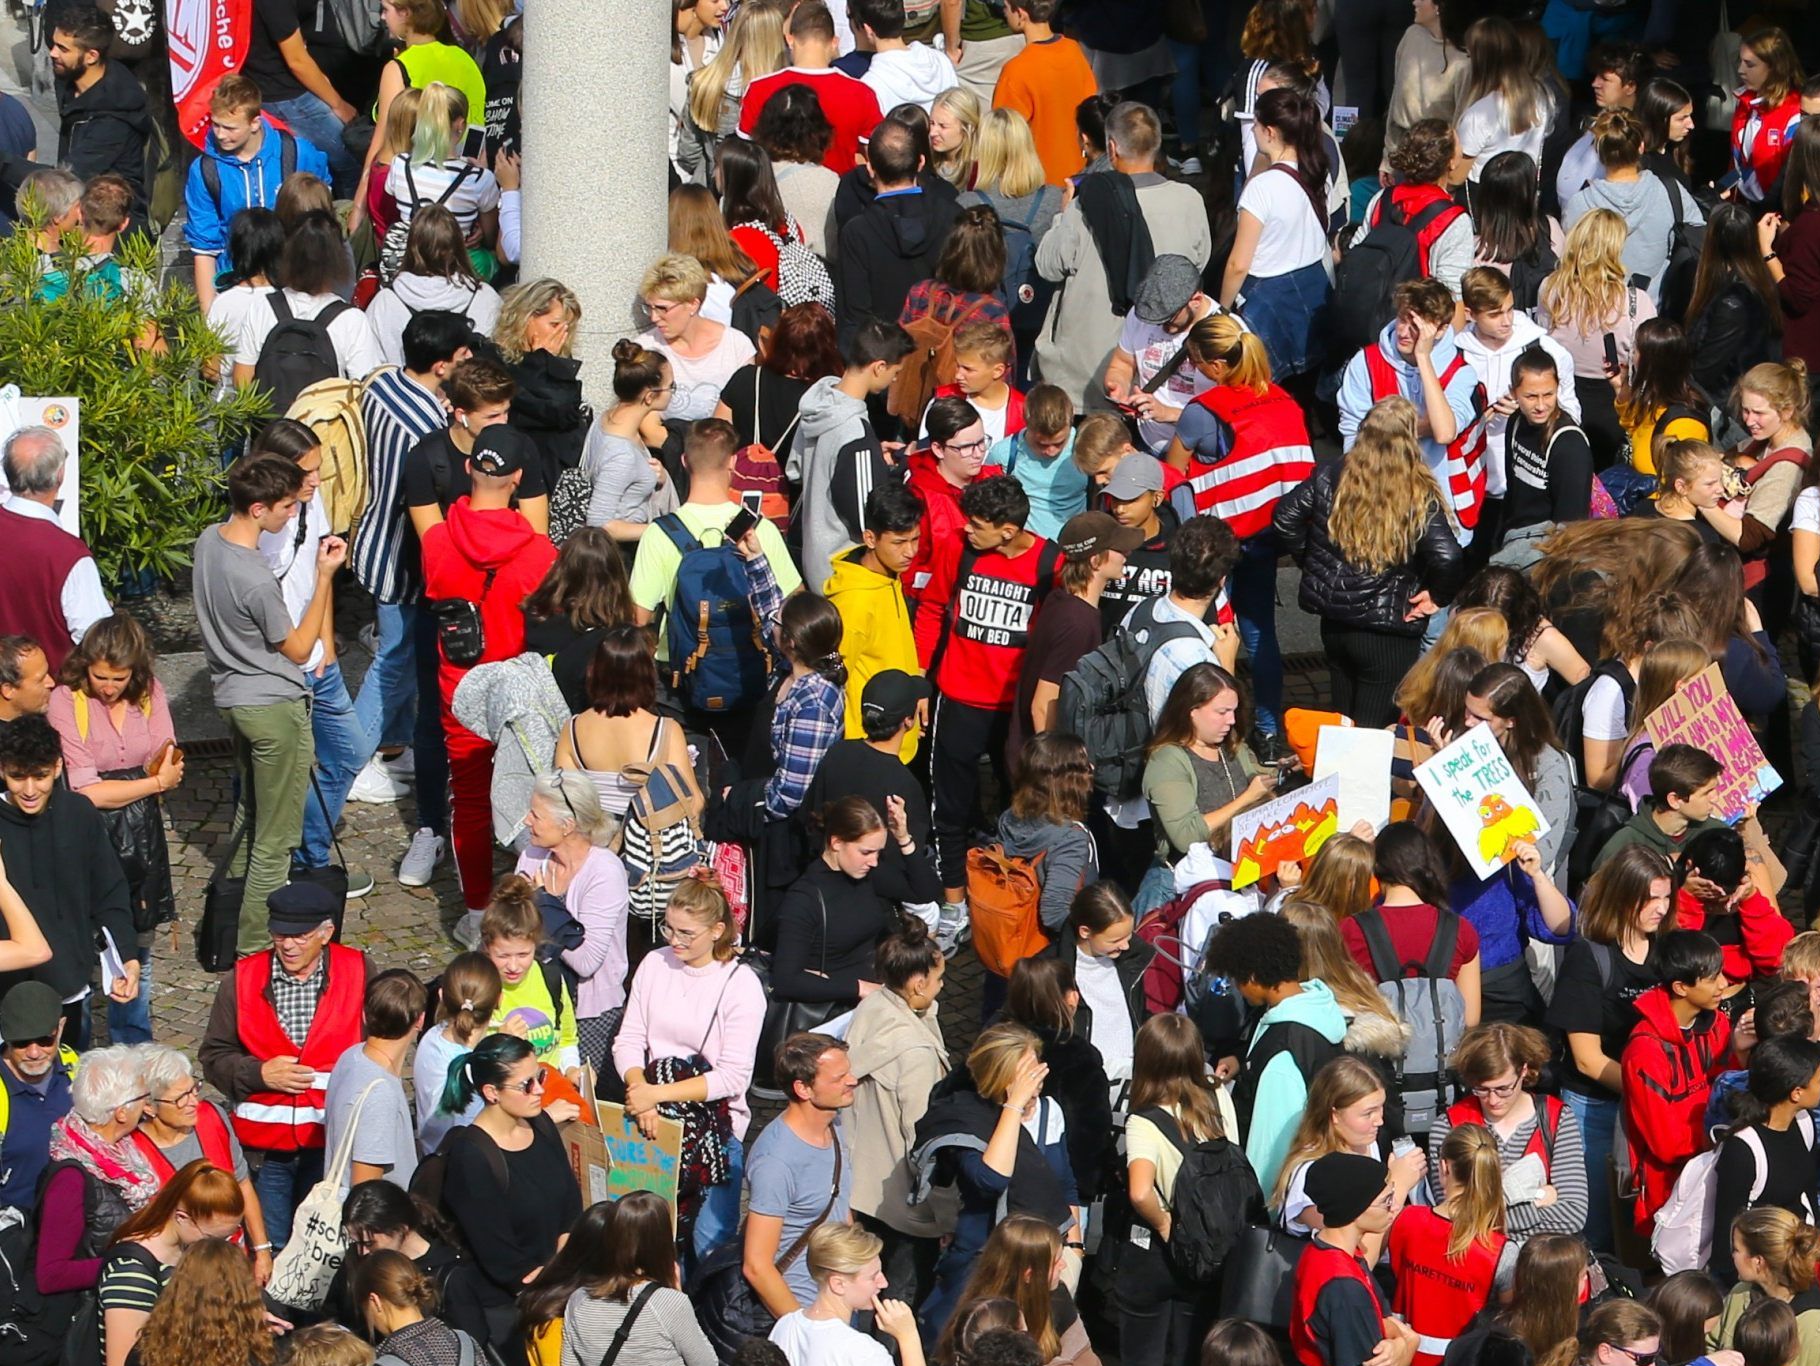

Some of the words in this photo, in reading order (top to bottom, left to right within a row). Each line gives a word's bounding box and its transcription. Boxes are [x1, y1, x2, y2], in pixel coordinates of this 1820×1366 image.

[966, 575, 1031, 601] STRAIGHT
[965, 594, 1023, 627] OUTTA
[967, 624, 984, 641] MY
[986, 629, 1010, 646] BED
[1650, 699, 1686, 742] WILL
[1682, 673, 1713, 713] YOU
[1428, 767, 1442, 787] I
[1442, 748, 1475, 781] speak
[1473, 739, 1491, 761] for
[1452, 787, 1474, 807] the
[1472, 755, 1511, 792] TREES
